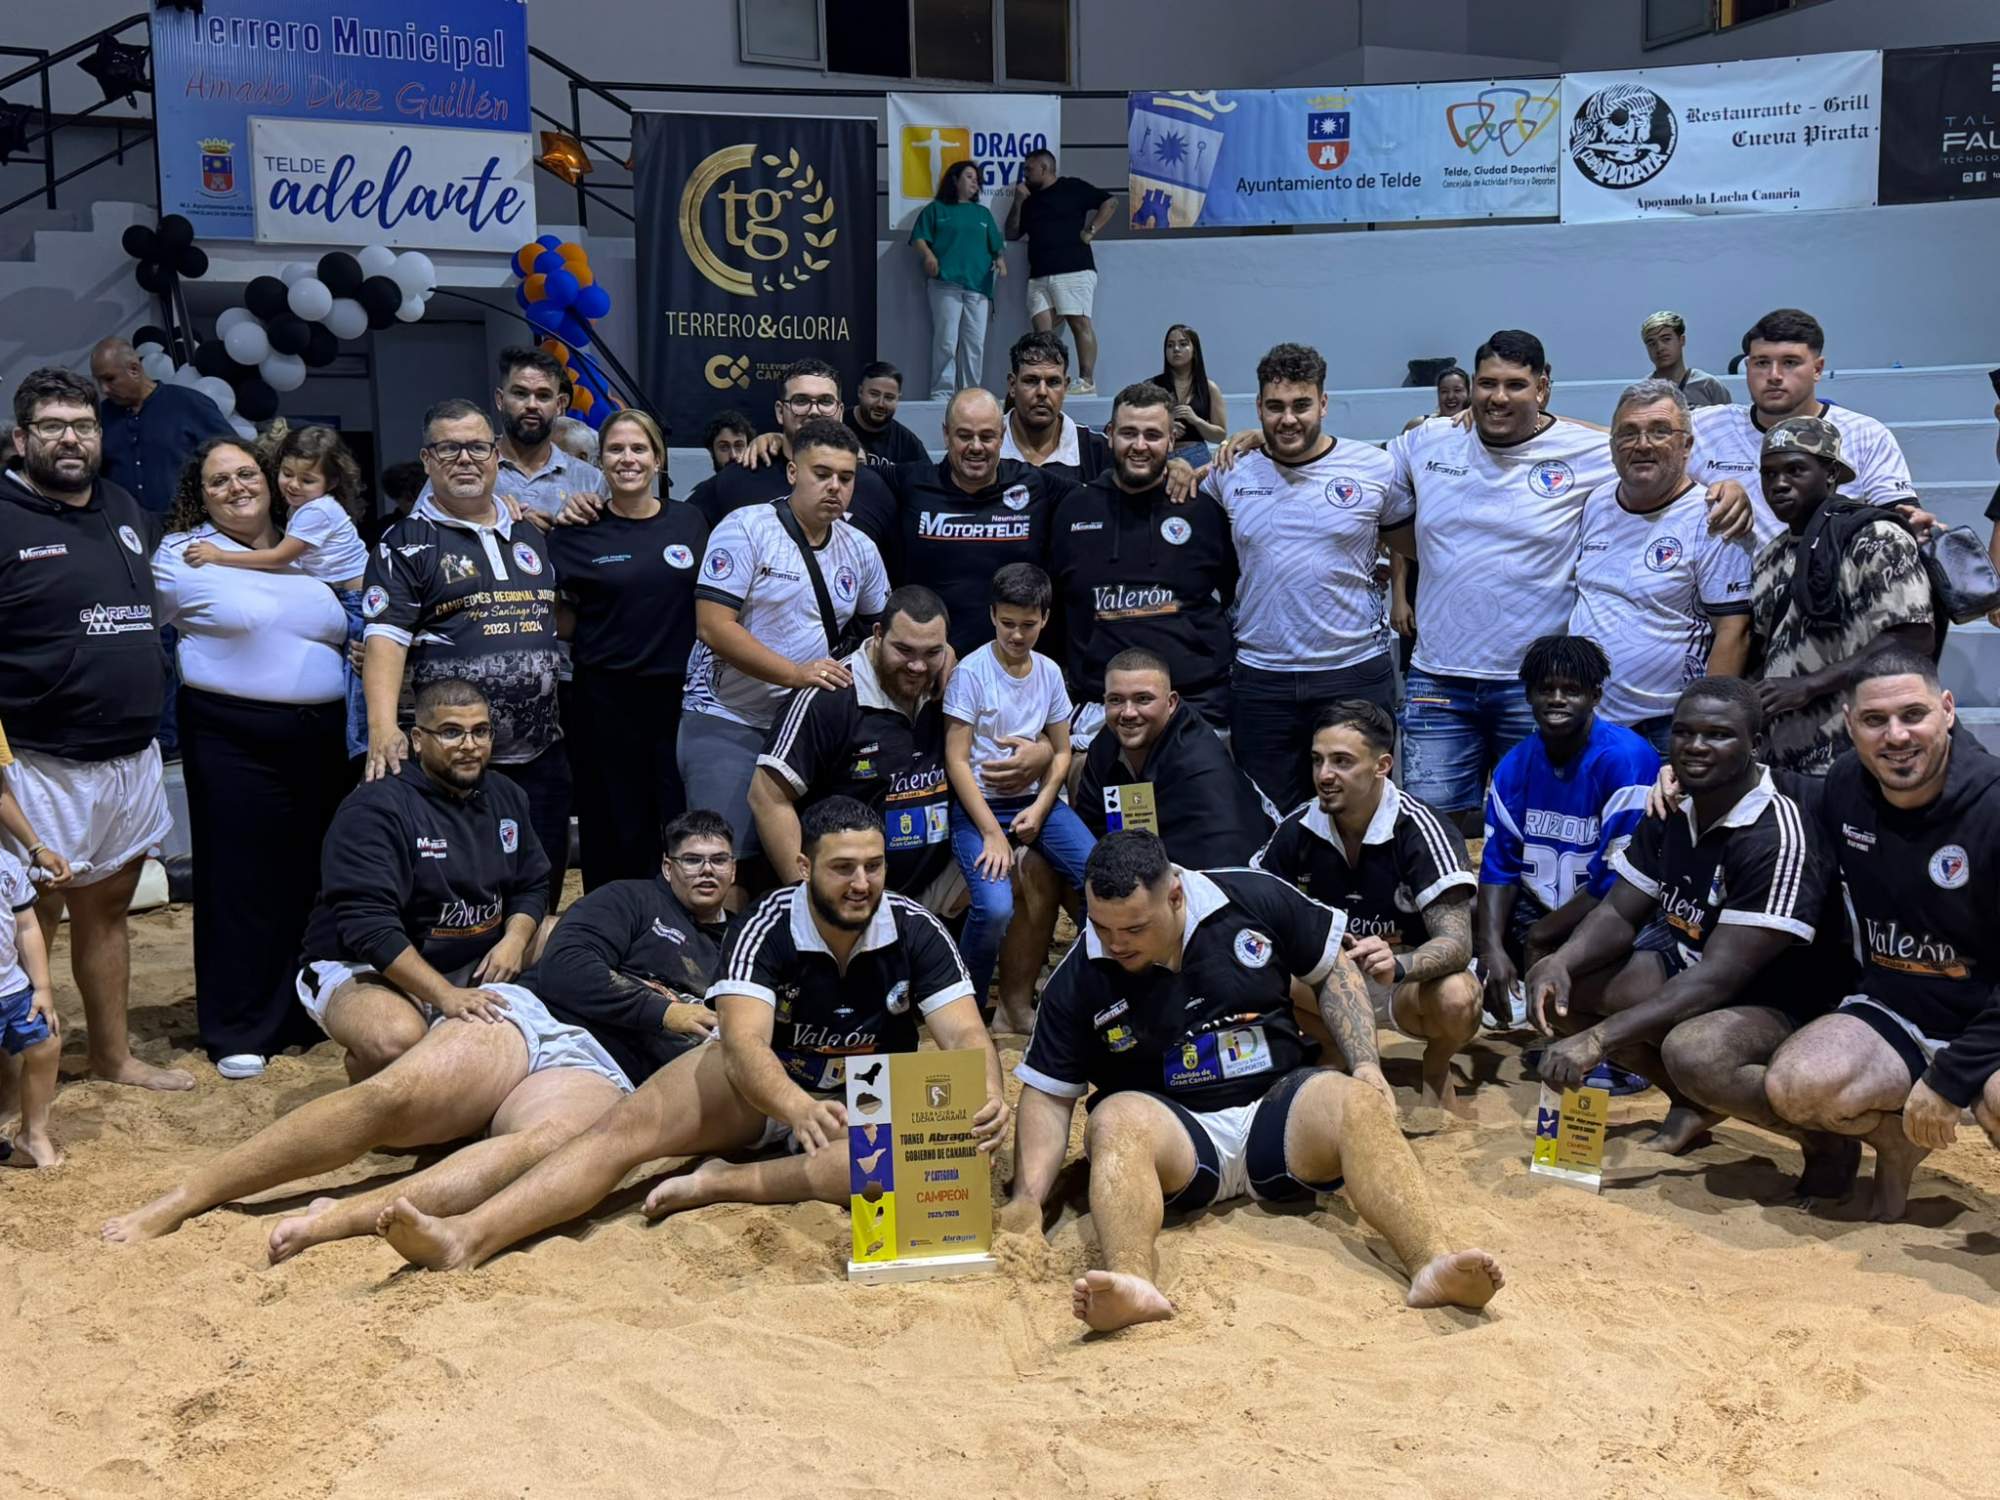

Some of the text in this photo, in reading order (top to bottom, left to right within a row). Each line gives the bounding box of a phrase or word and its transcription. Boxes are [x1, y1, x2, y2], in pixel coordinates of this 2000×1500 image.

[332, 16, 505, 71] Municipal
[185, 72, 509, 121] Amado Díaz Guillén
[1686, 102, 1801, 123] Restaurante
[1823, 94, 1870, 113] Grill
[973, 133, 1047, 158] DRAGO
[1732, 124, 1869, 148] Cueva Pirata
[264, 155, 327, 174] TELDE
[979, 161, 1026, 186] GY
[1443, 164, 1557, 178] Telde, Ciudad Deportiva
[269, 145, 526, 232] adelante
[1236, 172, 1422, 196] Ayuntamiento de Telde
[1635, 187, 1801, 211] Apoyando la Lucha Canaria
[665, 311, 850, 341] TERRERO&GLORIA
[918, 511, 1031, 537] MOTORTELDE
[436, 591, 492, 616] CAMPEONES
[494, 590, 535, 603] REGIONAL
[1092, 584, 1173, 611] Valerón
[483, 623, 511, 635] 2023
[519, 620, 543, 633] 2024
[1170, 1074, 1217, 1087] Gran Canaria
[1172, 1068, 1211, 1080] Cabildo de
[900, 1133, 924, 1146] TORNEO
[905, 1146, 977, 1162] GOBIERNO DE CANARIAS
